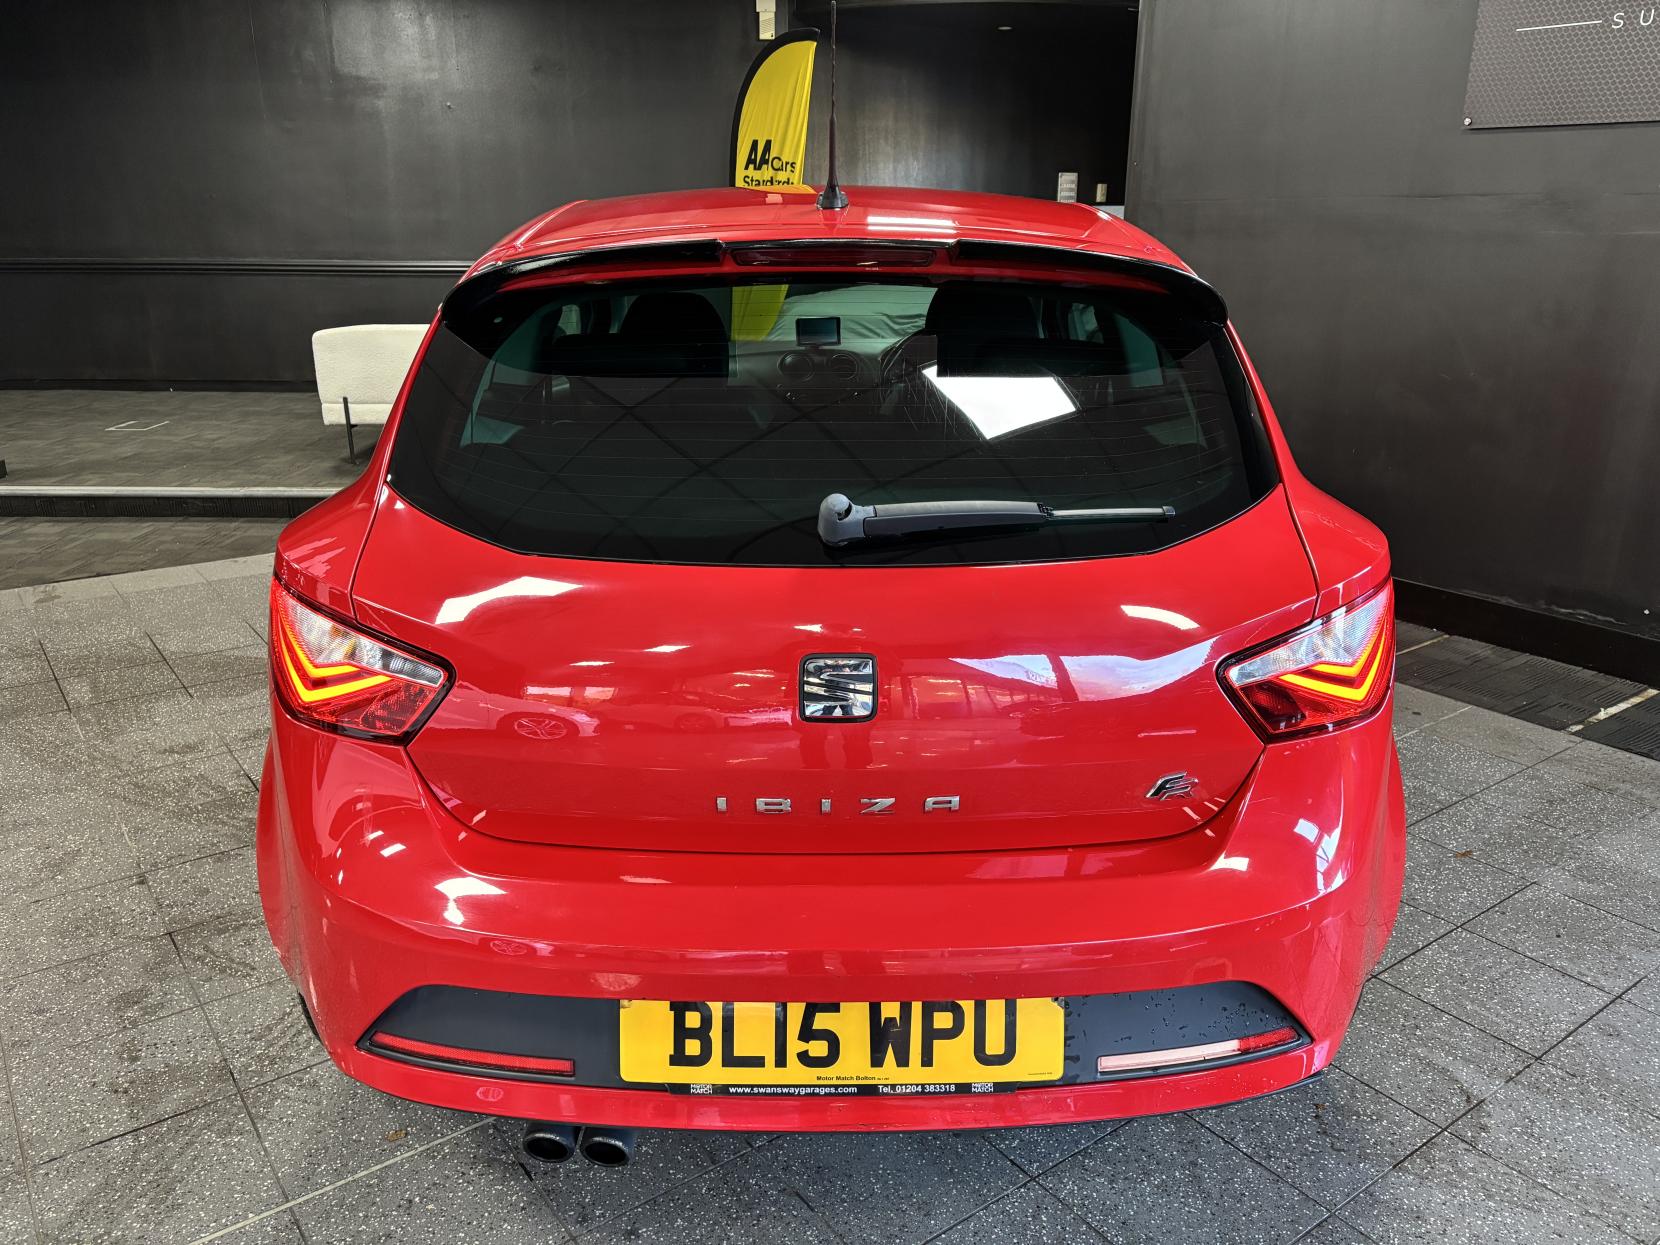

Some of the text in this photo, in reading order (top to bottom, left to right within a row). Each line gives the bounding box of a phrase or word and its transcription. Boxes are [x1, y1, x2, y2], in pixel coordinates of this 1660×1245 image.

[744, 139, 772, 170] AA
[743, 175, 795, 187] Stadrd
[716, 795, 960, 814] IBIZA
[669, 999, 1017, 1069] BL15 WPU
[728, 1086, 858, 1095] www.swanswaygarages.com
[895, 1084, 922, 1093] 01204
[924, 1084, 956, 1092] 383318
